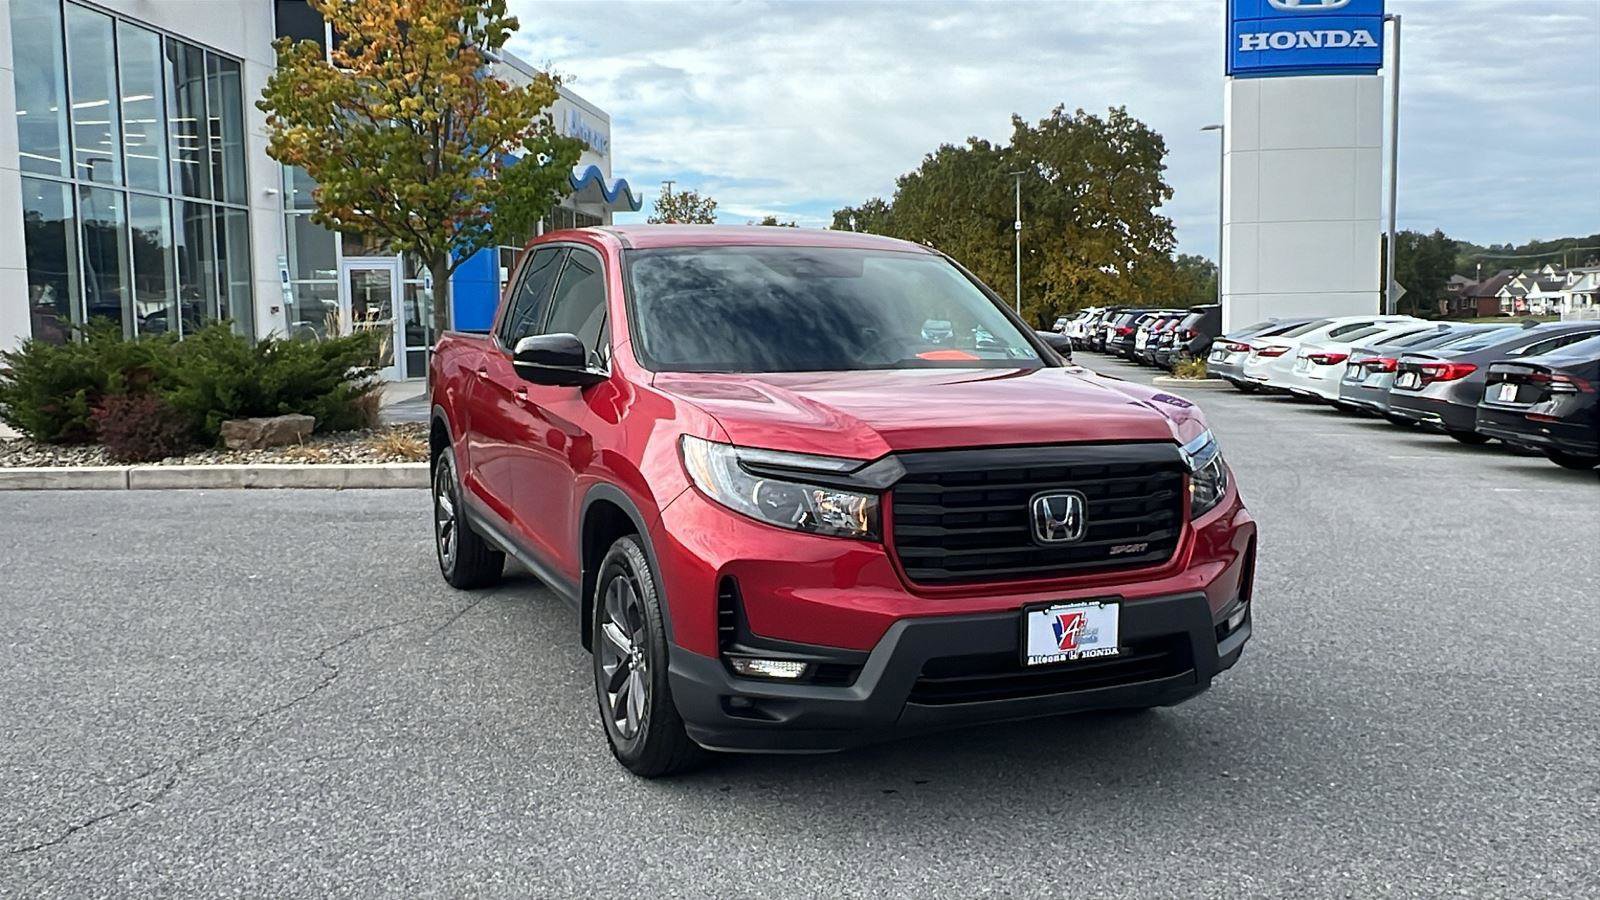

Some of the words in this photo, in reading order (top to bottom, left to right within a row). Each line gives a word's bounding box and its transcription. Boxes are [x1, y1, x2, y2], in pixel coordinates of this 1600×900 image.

[1239, 30, 1378, 51] HONDA
[1110, 542, 1148, 555] SPORT
[1082, 647, 1119, 659] HONDA
